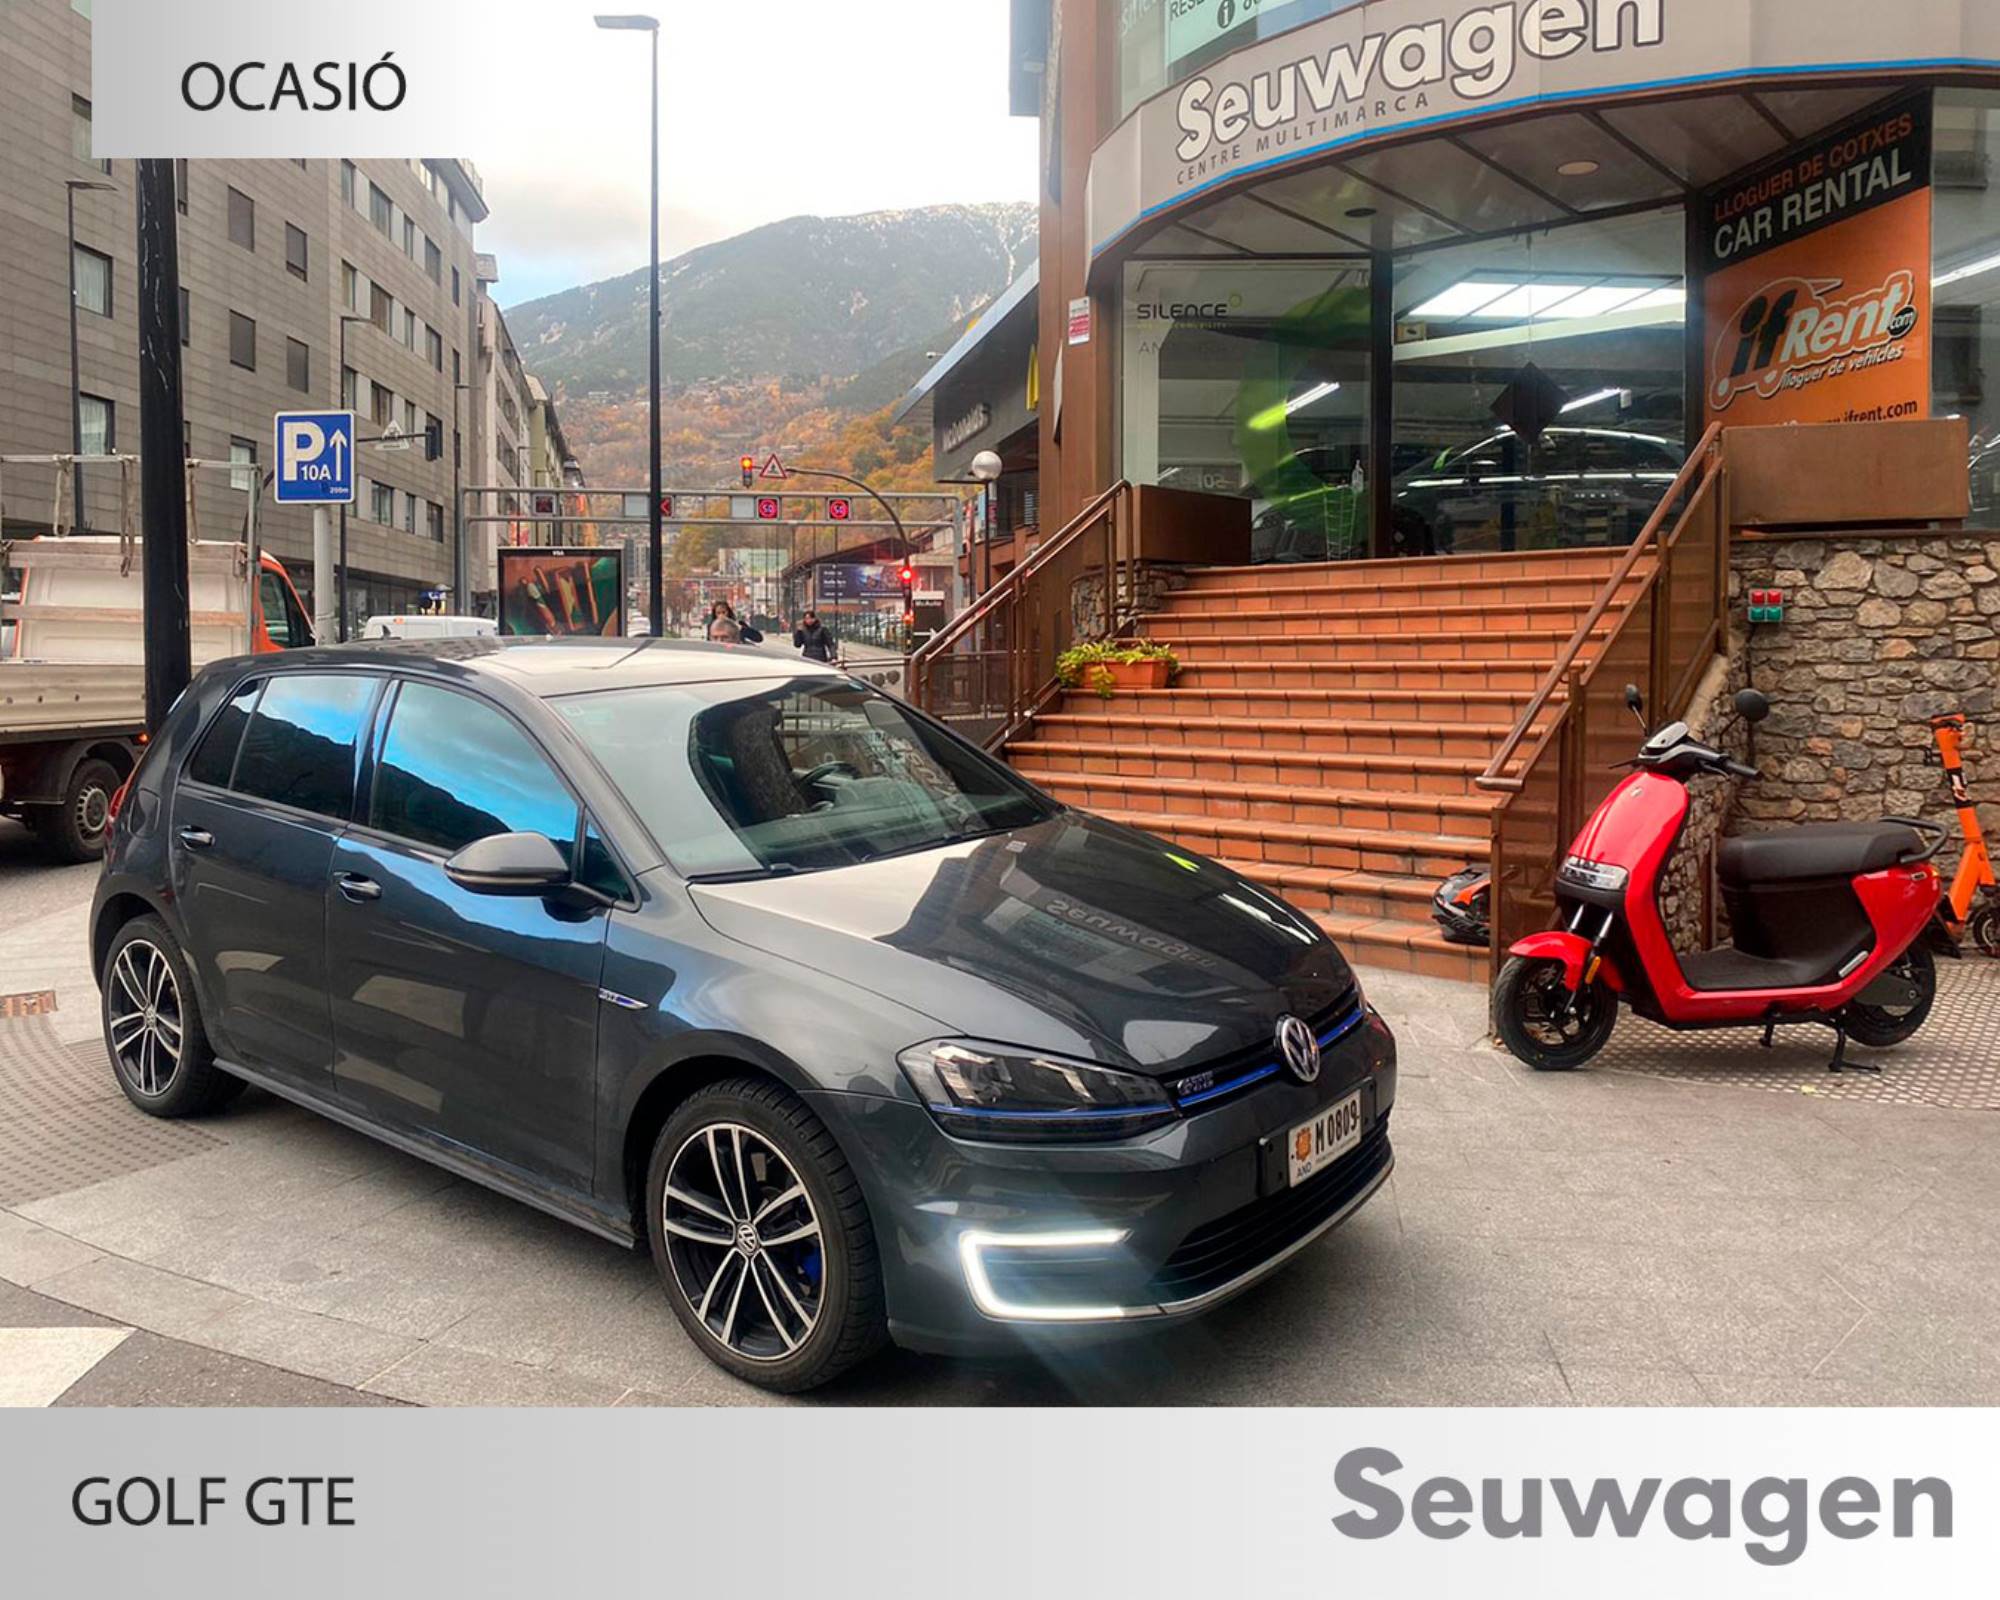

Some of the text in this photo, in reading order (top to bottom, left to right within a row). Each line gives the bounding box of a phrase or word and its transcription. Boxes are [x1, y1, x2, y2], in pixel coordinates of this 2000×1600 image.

[1176, 0, 1663, 161] Seuwagen
[1176, 92, 1429, 186] CENTRE MULTIMARCA
[1715, 112, 1914, 221] LLOGUER DE COTXES
[1714, 148, 1912, 259] CAR RENTAL
[1780, 343, 1905, 392] lloguer de vehicles
[283, 421, 325, 481] P
[301, 464, 332, 481] 10A
[1315, 1117, 1326, 1156] M
[1327, 1099, 1361, 1147] 0809
